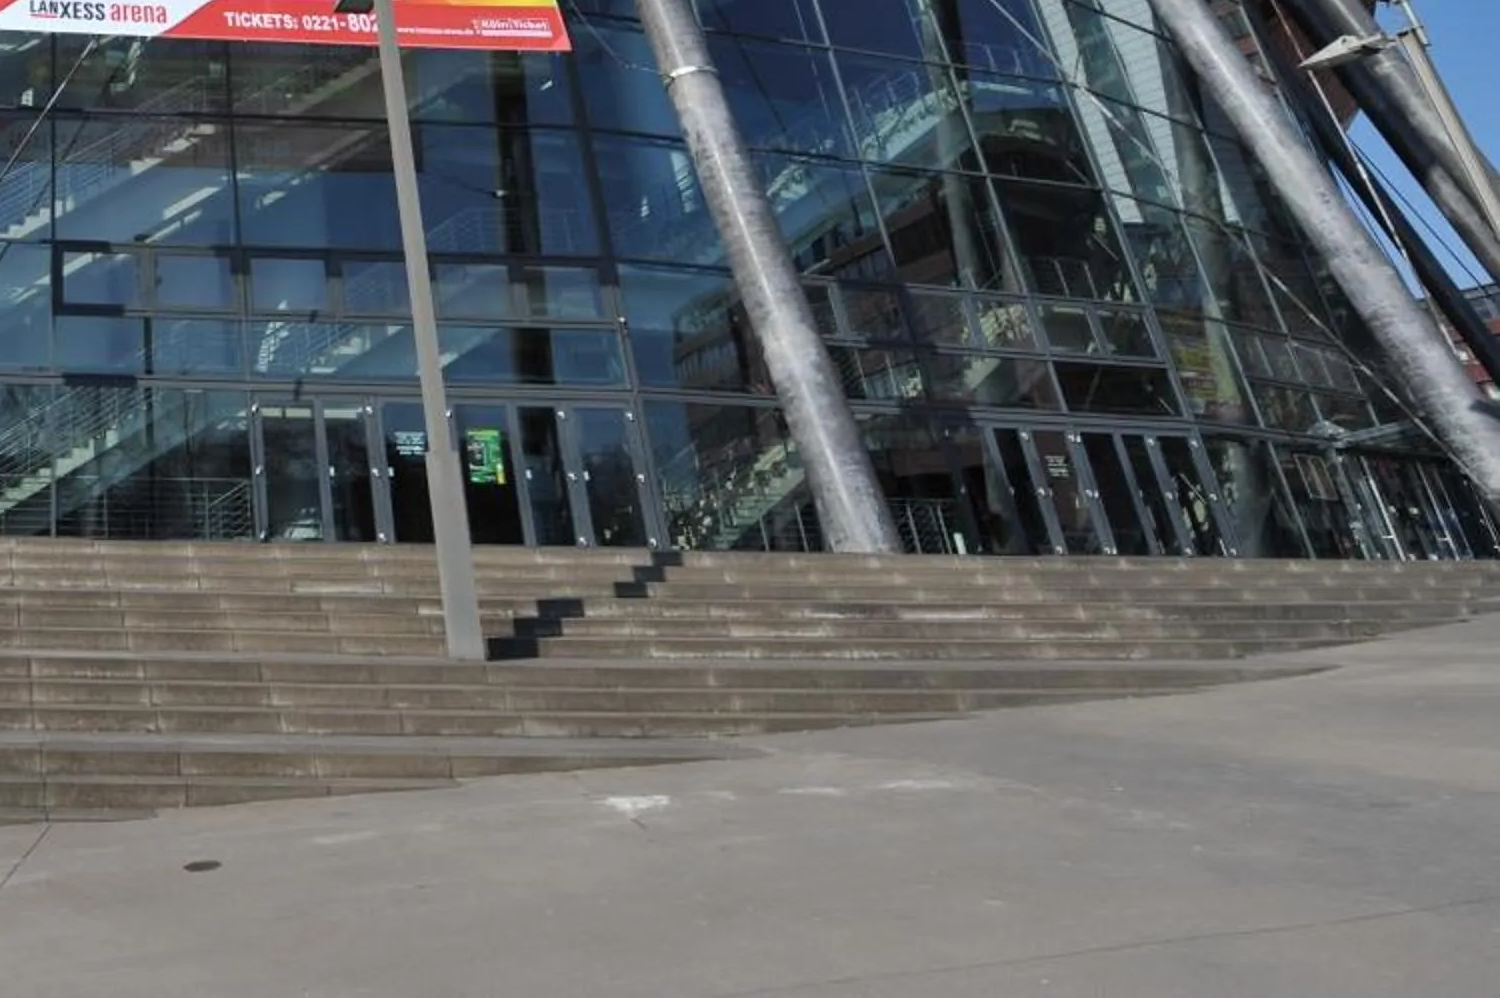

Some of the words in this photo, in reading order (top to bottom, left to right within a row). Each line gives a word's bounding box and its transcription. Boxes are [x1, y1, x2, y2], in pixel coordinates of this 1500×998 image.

[29, 0, 106, 21] LANXESS
[110, 2, 168, 24] arena
[223, 11, 299, 30] TICKETS:
